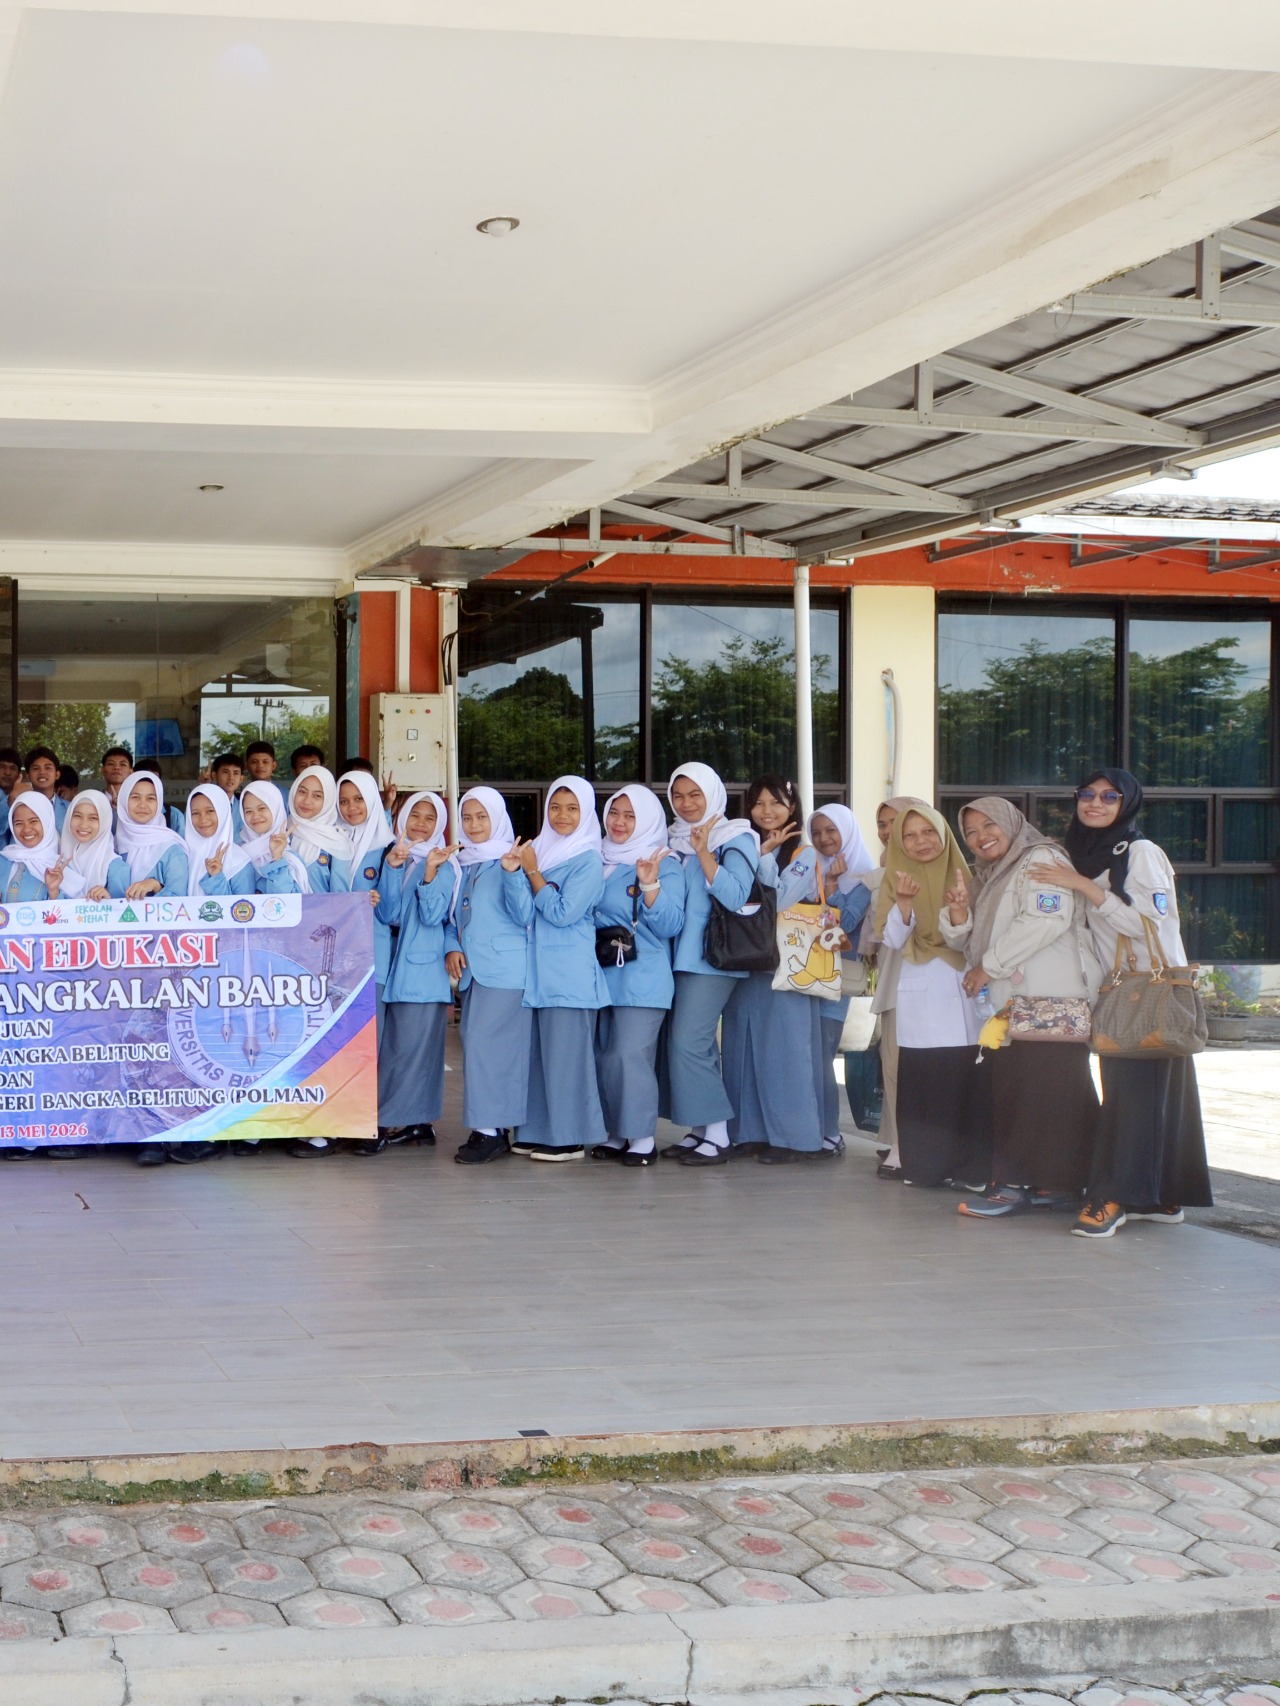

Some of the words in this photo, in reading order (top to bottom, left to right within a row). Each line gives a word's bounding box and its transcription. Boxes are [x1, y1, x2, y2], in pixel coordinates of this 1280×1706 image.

[75, 904, 112, 913] SEKOLAH
[144, 902, 191, 923] PISA
[83, 914, 109, 924] SEHAT
[41, 933, 220, 972] EDUKASI
[218, 974, 329, 1008] BARU
[72, 1043, 169, 1062] BELITUNG
[42, 1092, 124, 1109] BANGKA
[128, 1089, 227, 1106] BELITUNG
[230, 1086, 325, 1105] (POLMAN)
[0, 1126, 15, 1139] 13
[18, 1125, 46, 1138] MEI
[50, 1123, 88, 1137] 2026
